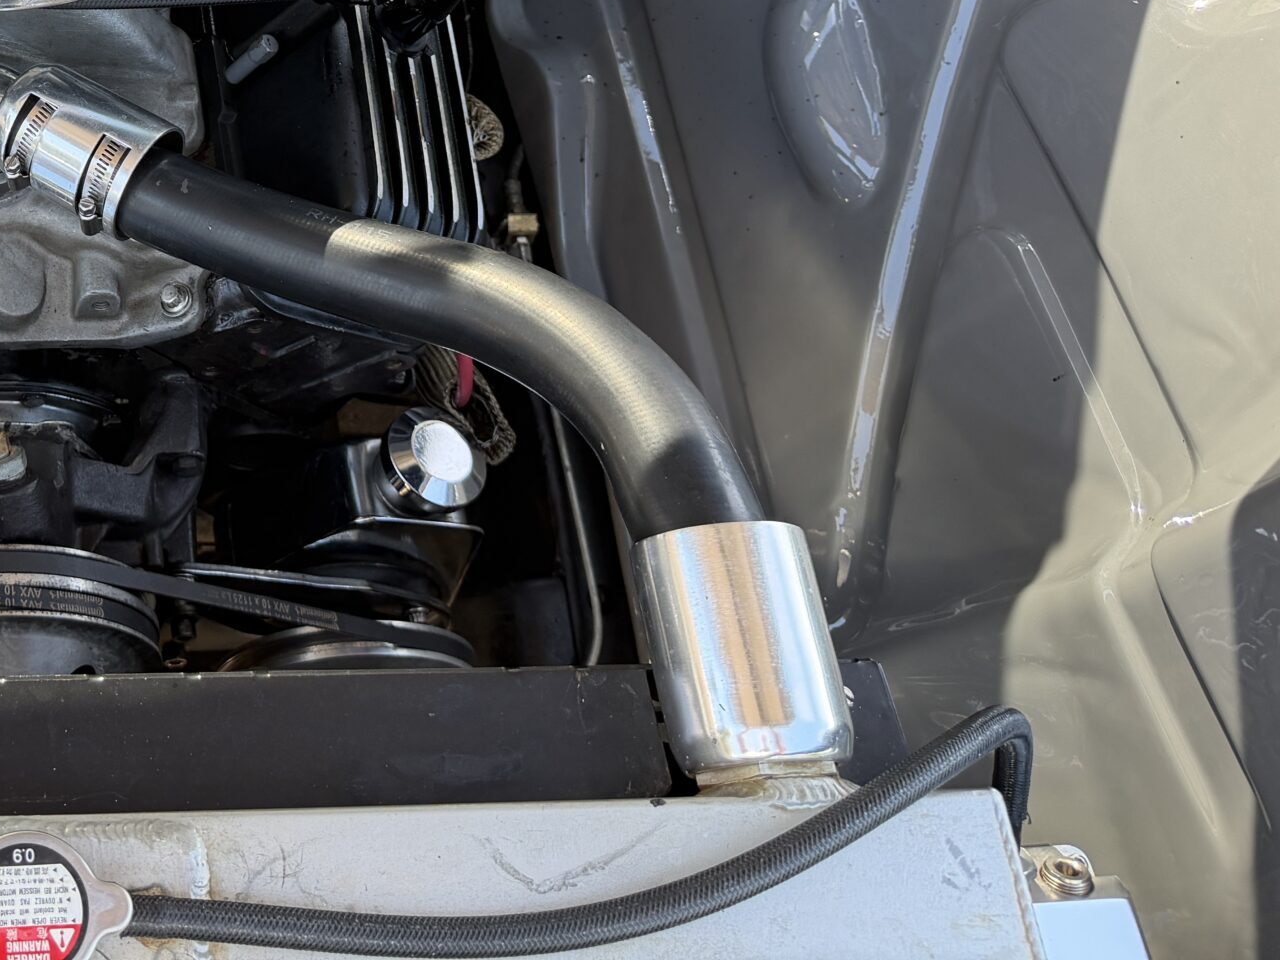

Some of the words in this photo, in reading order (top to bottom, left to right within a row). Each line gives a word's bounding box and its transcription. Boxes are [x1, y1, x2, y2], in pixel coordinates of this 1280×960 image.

[4, 584, 16, 596] 10
[20, 586, 42, 599] AVX
[233, 593, 253, 604] 1125
[20, 599, 42, 609] AVX
[262, 598, 271, 609] 10
[274, 601, 291, 614] AVX
[12, 848, 35, 863] 0.9
[0, 888, 17, 896] MOTOR
[19, 887, 41, 895] HEISSEM
[43, 887, 52, 895] BEI
[54, 886, 69, 894] NICHT
[20, 898, 31, 906] PAS
[19, 908, 30, 916] will
[33, 907, 55, 915] coolant
[10, 918, 27, 926] WHEN
[32, 917, 47, 925] OPEN
[49, 916, 67, 924] NEVER
[6, 939, 50, 953] WARNING
